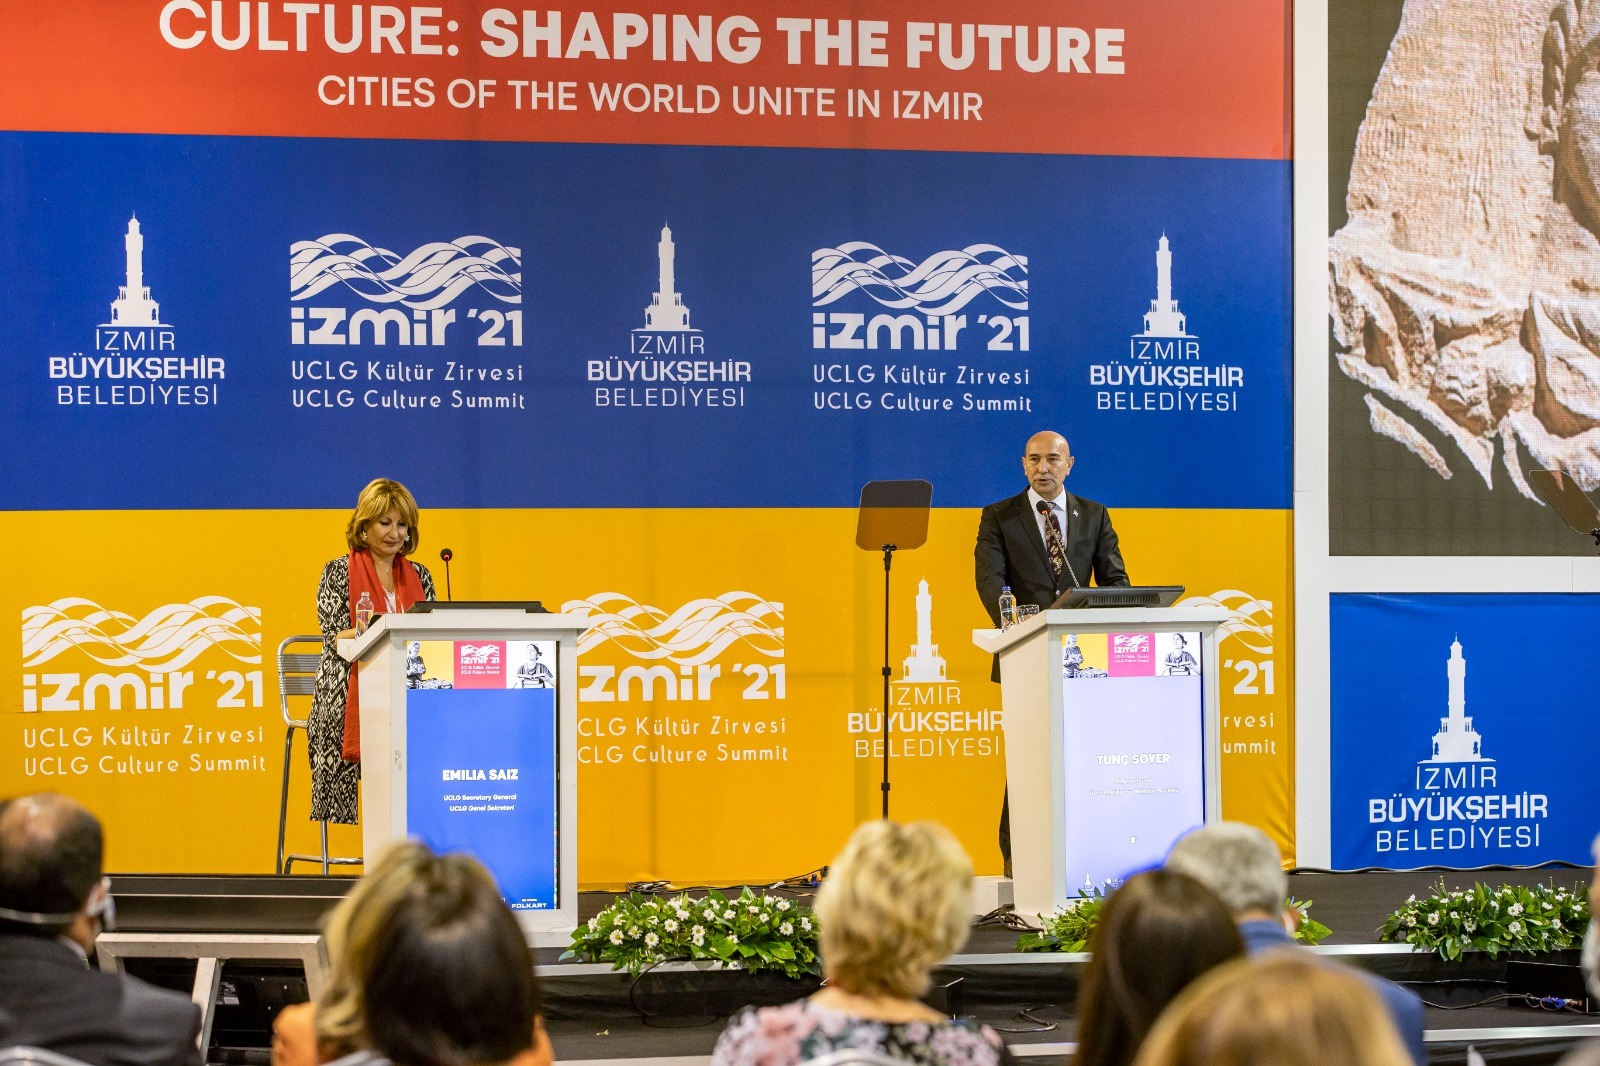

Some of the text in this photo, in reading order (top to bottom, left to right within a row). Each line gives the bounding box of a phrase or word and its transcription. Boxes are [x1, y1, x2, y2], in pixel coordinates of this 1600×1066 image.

[159, 0, 1126, 75] CULTURE: SHAPING THE FUTURE
[317, 74, 436, 108] CITIES
[446, 78, 497, 109] OF
[507, 80, 578, 111] THE
[588, 82, 721, 114] WORLD
[732, 85, 836, 117] UNITE
[893, 90, 983, 121] IZMIR
[290, 308, 523, 347] izmir '21
[812, 314, 1030, 352] izmir '21
[95, 328, 175, 351] İZMİR
[631, 333, 705, 355] İZMİR
[1130, 338, 1200, 360] İZMİR
[49, 352, 225, 382] BÜYÜKŞEHİR
[291, 360, 523, 382] UCLG Kültür Zirvesi
[587, 355, 752, 385] BÜYÜKŞEHİR
[813, 364, 1029, 386] UCLG Kültür Zirvesi
[1089, 360, 1244, 390] BÜYÜKŞEHİR
[57, 383, 217, 405] BELEDİYESİ
[292, 389, 525, 410] UCLG Culture Summit
[595, 386, 744, 407] BELEDİYESİ
[814, 391, 1032, 413] UCLG Culture Summit
[1097, 388, 1237, 412] BELEDİYESİ
[578, 663, 786, 703] zmir '21
[1223, 659, 1275, 695] '21
[22, 669, 264, 713] izmir '21
[889, 684, 961, 706] İZMİR
[577, 715, 786, 737] CLG Kültür Zirvesi
[1223, 712, 1274, 728] rvesi
[23, 724, 263, 749] UCLG Kültür Zirvesi
[1222, 739, 1277, 755] ummit
[24, 753, 266, 777] UCLG Culture Summit
[577, 743, 788, 764] CLG Culture Summit
[1096, 752, 1170, 767] TUNÇ SOYER
[442, 768, 519, 781] EMILIA SAIZ
[1416, 765, 1497, 790] İZMİR
[1369, 791, 1548, 824] BÜYÜKŞEHİR
[1375, 823, 1540, 852] BELEDİYESİ
